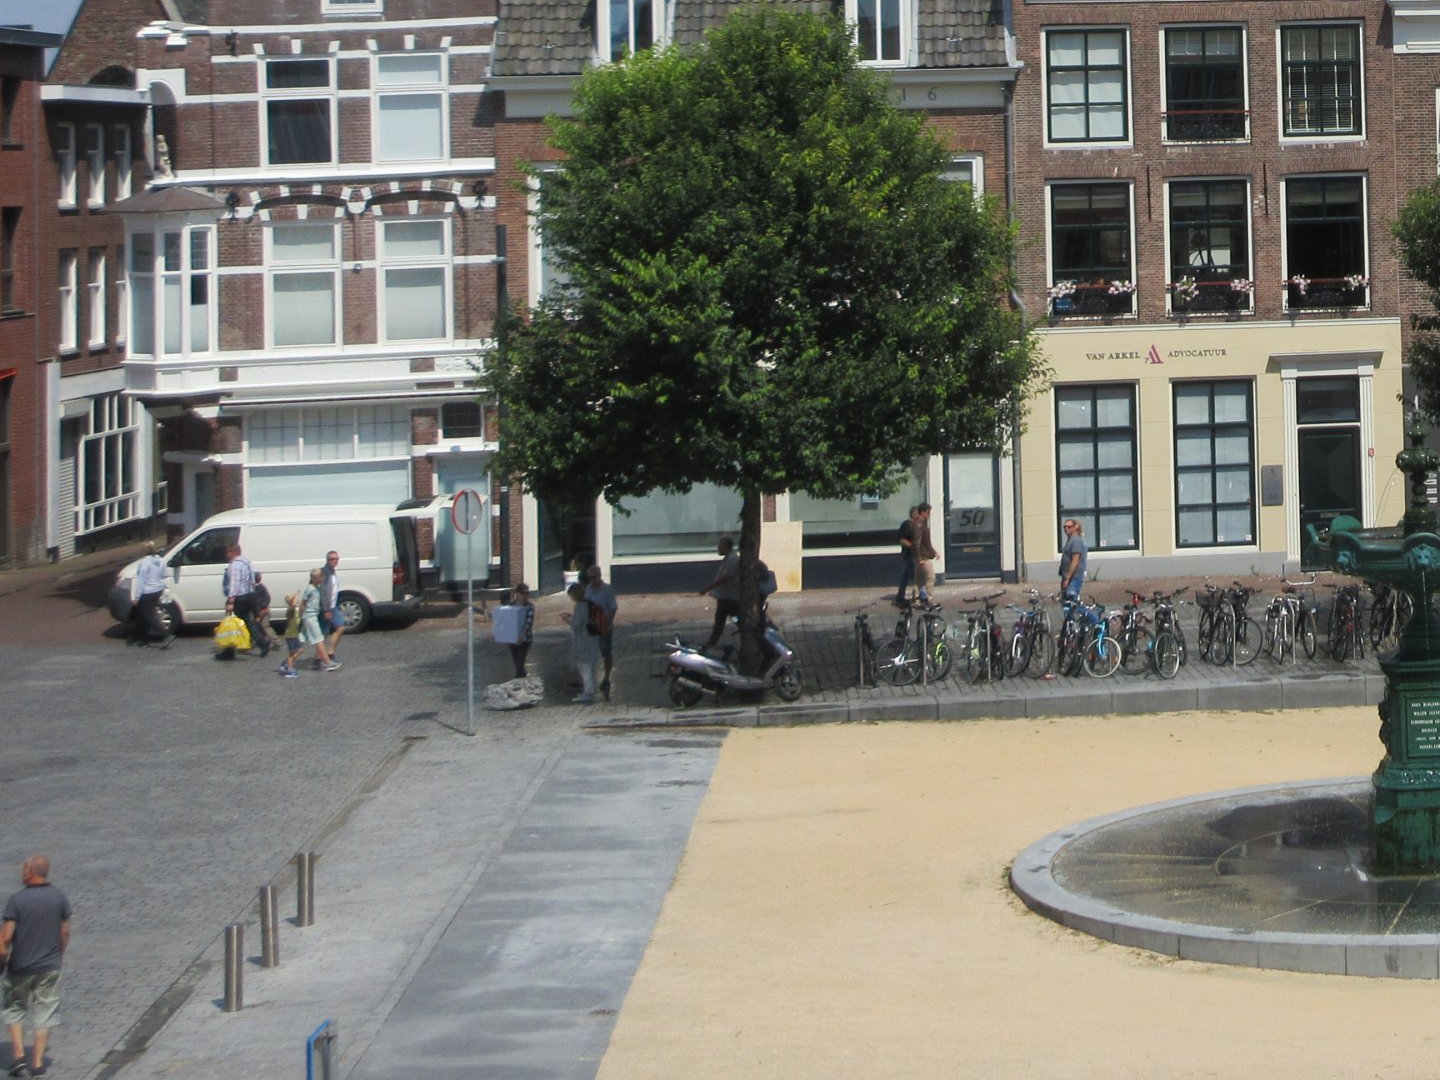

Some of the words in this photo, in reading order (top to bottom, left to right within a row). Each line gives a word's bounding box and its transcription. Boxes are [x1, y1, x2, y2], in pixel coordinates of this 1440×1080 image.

[1086, 353, 1105, 361] VAN
[1108, 351, 1141, 360] ARKEL
[1167, 348, 1227, 358] ADVOCATUUR
[959, 509, 985, 527] 50
